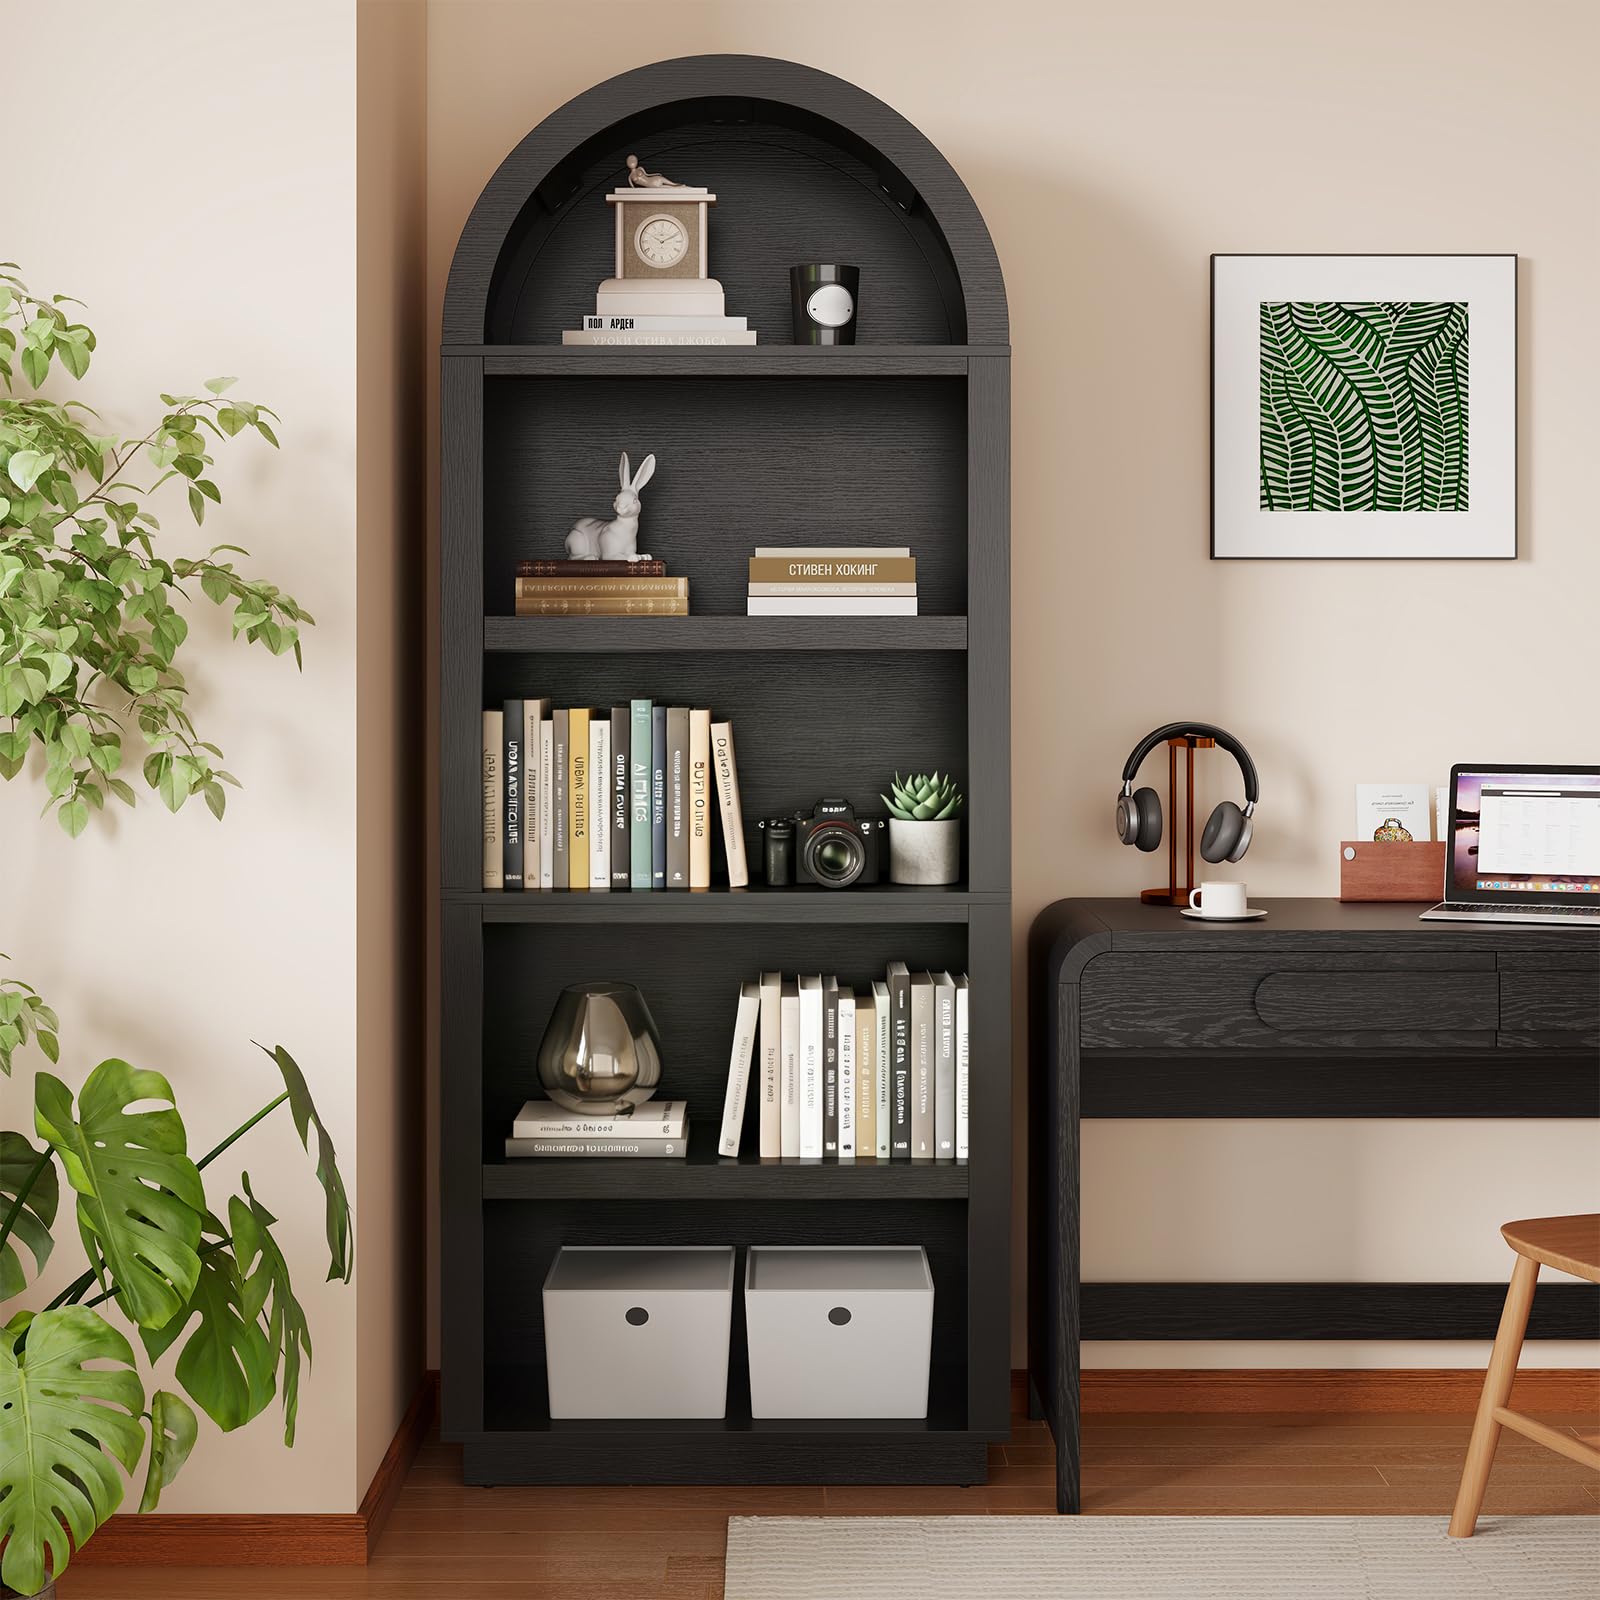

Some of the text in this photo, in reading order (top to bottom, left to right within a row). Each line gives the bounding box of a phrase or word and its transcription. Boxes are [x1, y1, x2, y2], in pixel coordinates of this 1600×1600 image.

[588, 318, 634, 330] ПОЛ АРДЕН
[592, 336, 631, 345] УРОКИ
[635, 336, 673, 345] СТИВА
[789, 563, 878, 576] СТИВЕН ХОКИНГ
